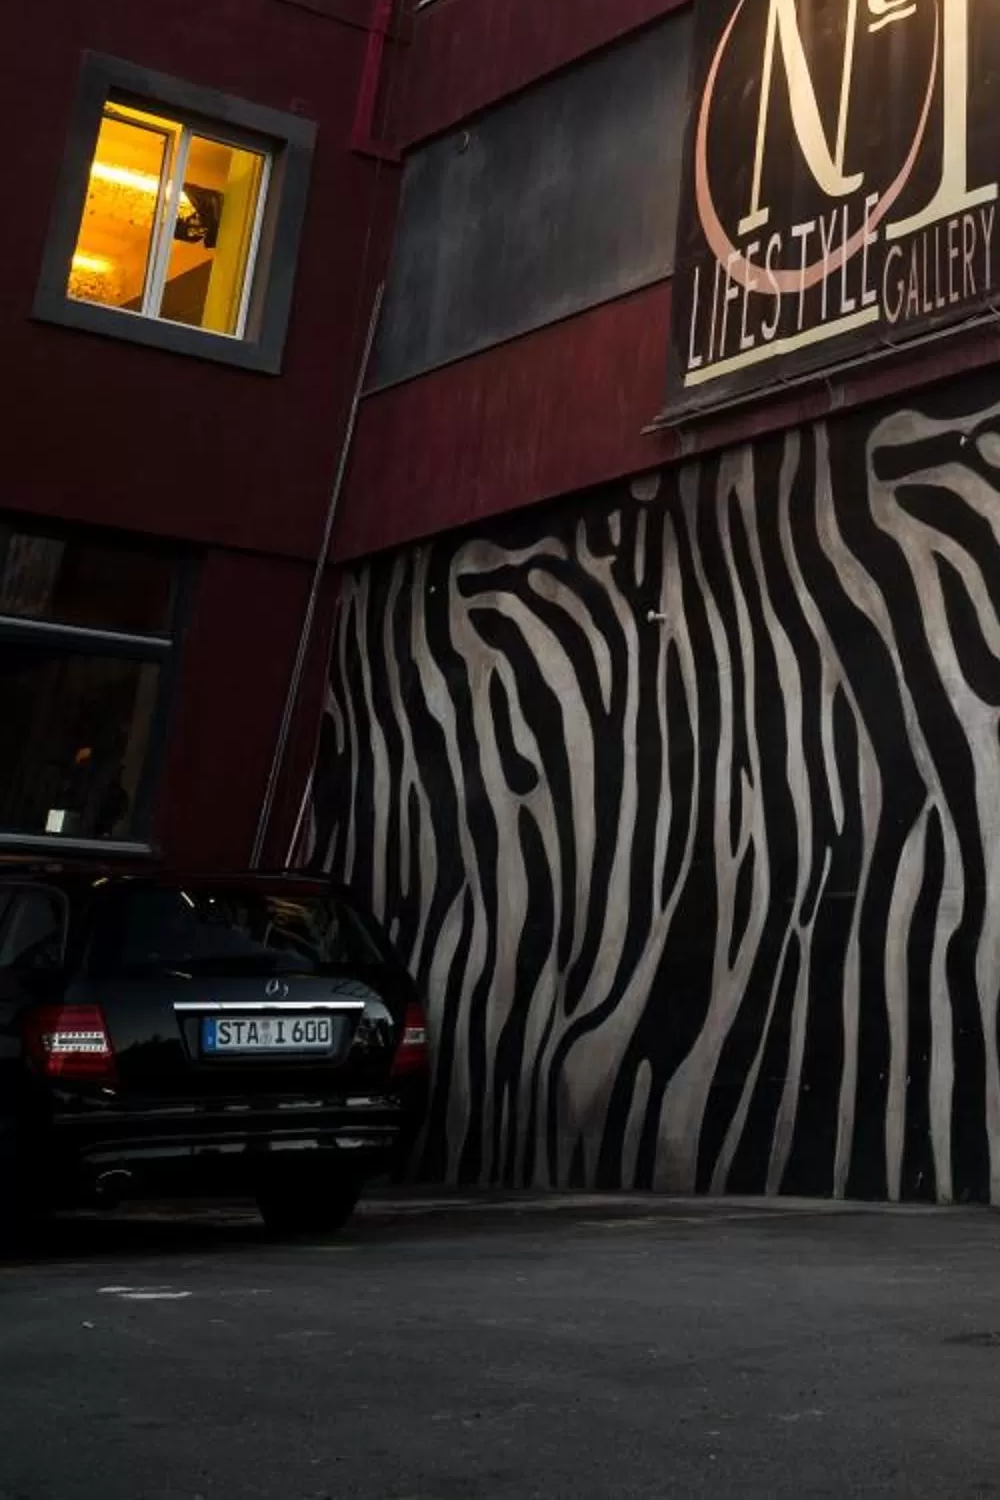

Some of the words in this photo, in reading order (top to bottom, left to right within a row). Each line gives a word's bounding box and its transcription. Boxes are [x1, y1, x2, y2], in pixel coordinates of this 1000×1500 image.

[687, 193, 879, 368] LIFESTYLE
[883, 206, 997, 323] GALLERY
[218, 1021, 260, 1045] STA
[291, 1020, 329, 1044] 600
